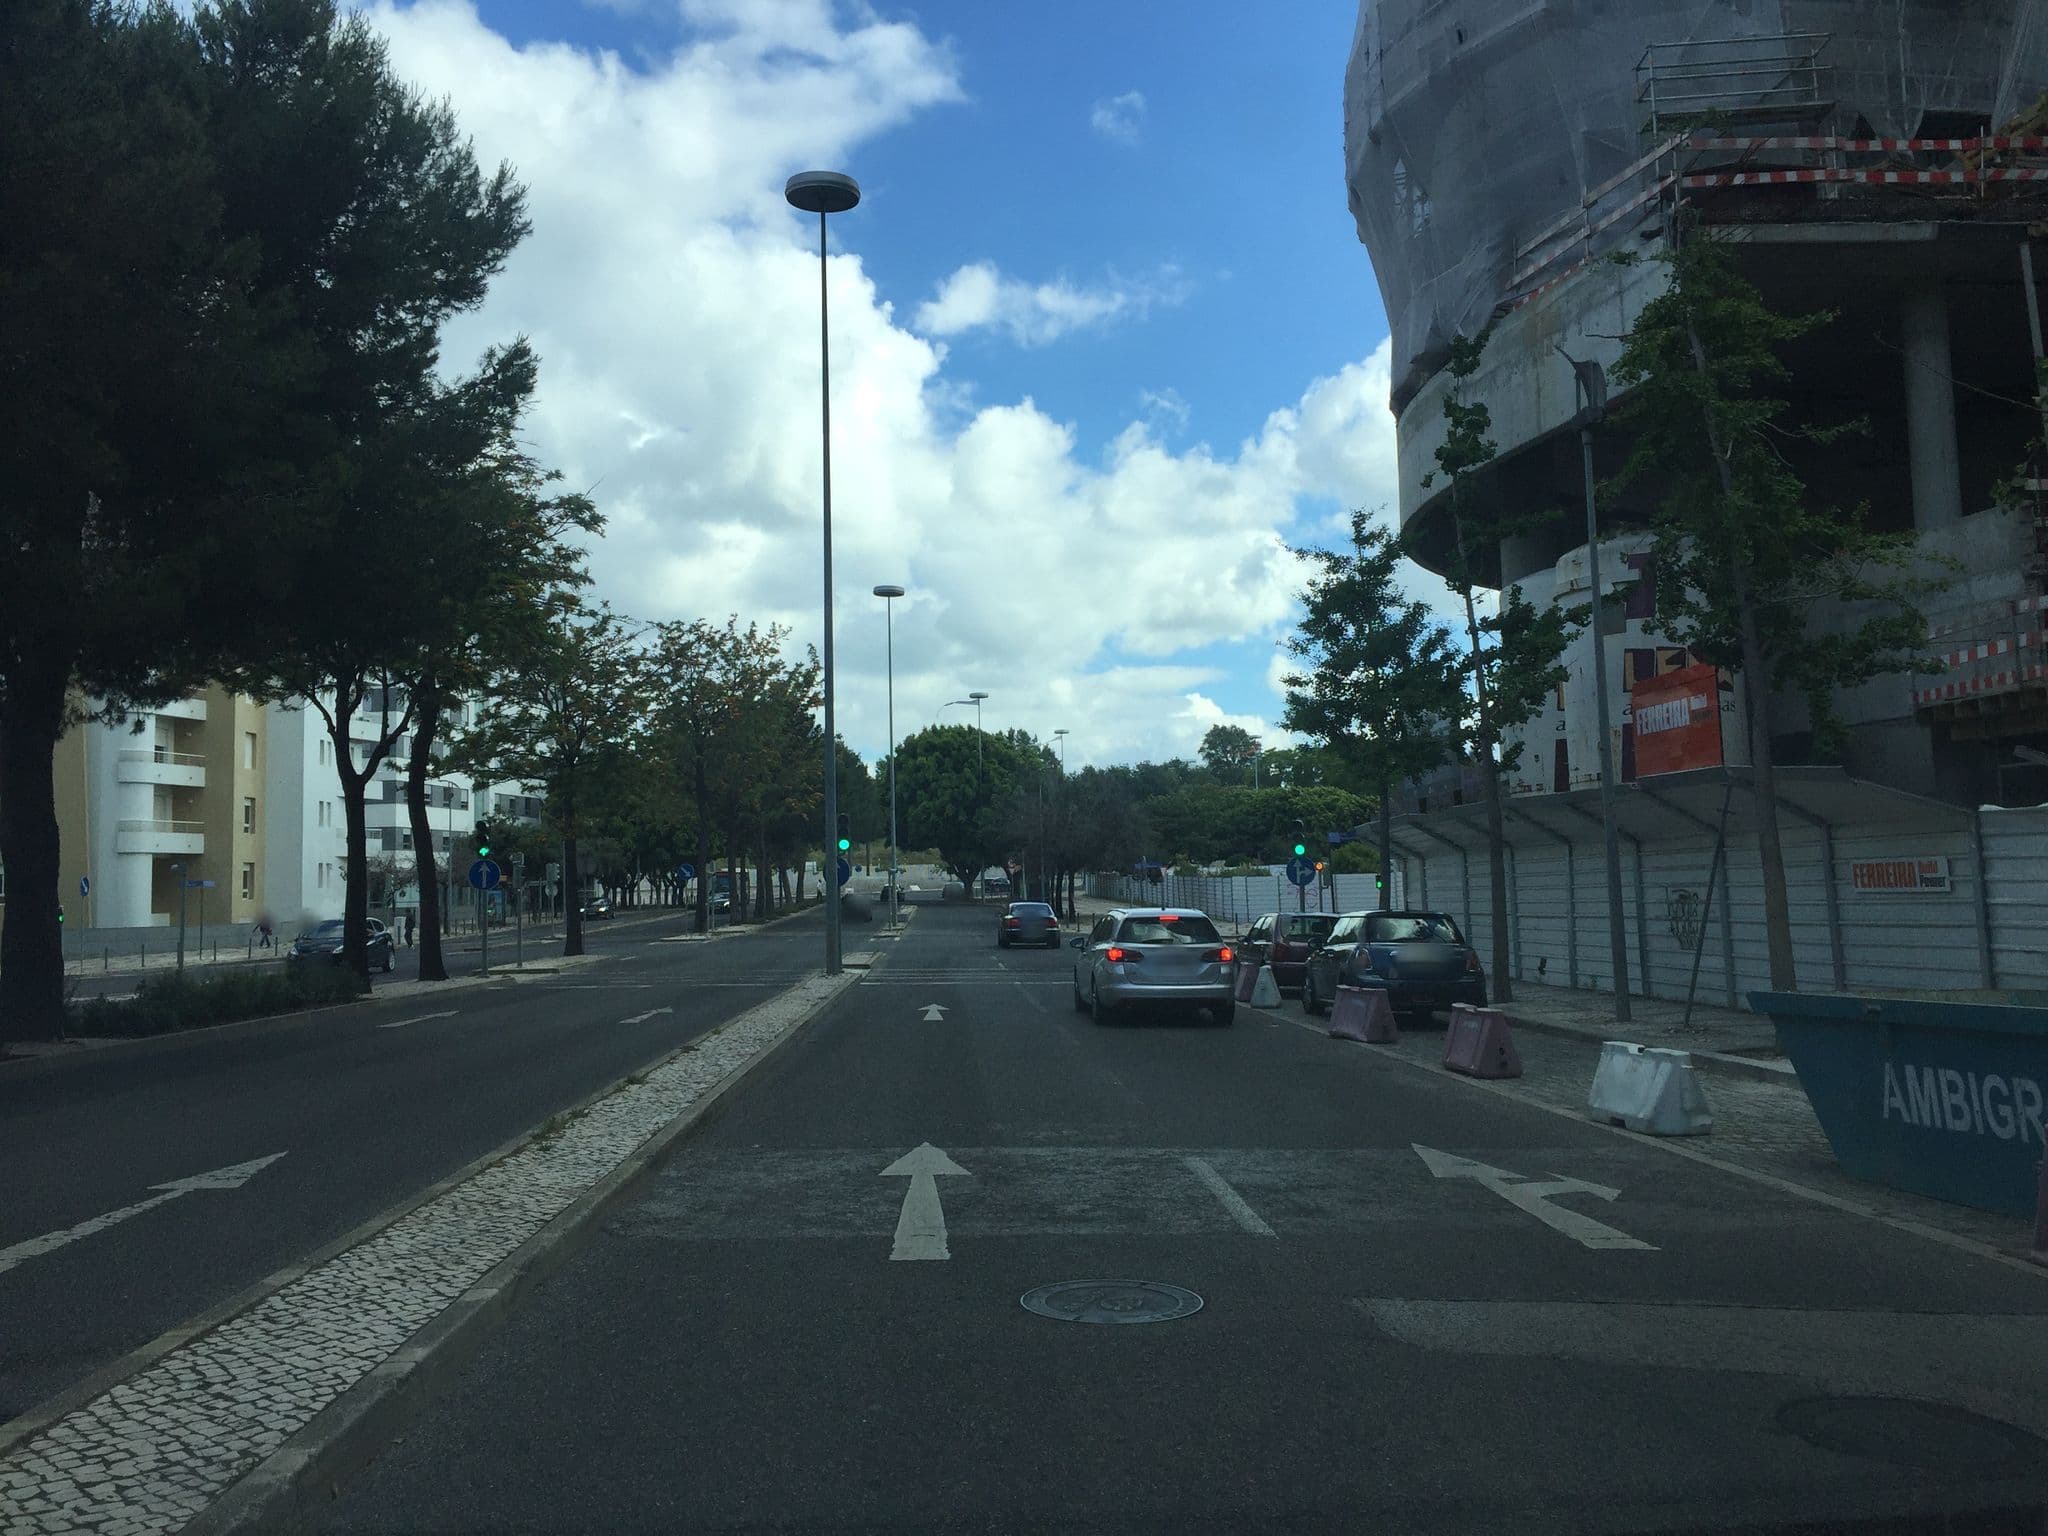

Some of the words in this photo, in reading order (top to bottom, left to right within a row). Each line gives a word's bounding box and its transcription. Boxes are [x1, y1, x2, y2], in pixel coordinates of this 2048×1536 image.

[1635, 698, 1690, 736] FERREIRA
[1853, 862, 1916, 888] FERREIRA
[1882, 1061, 2047, 1145] AMBIGR
